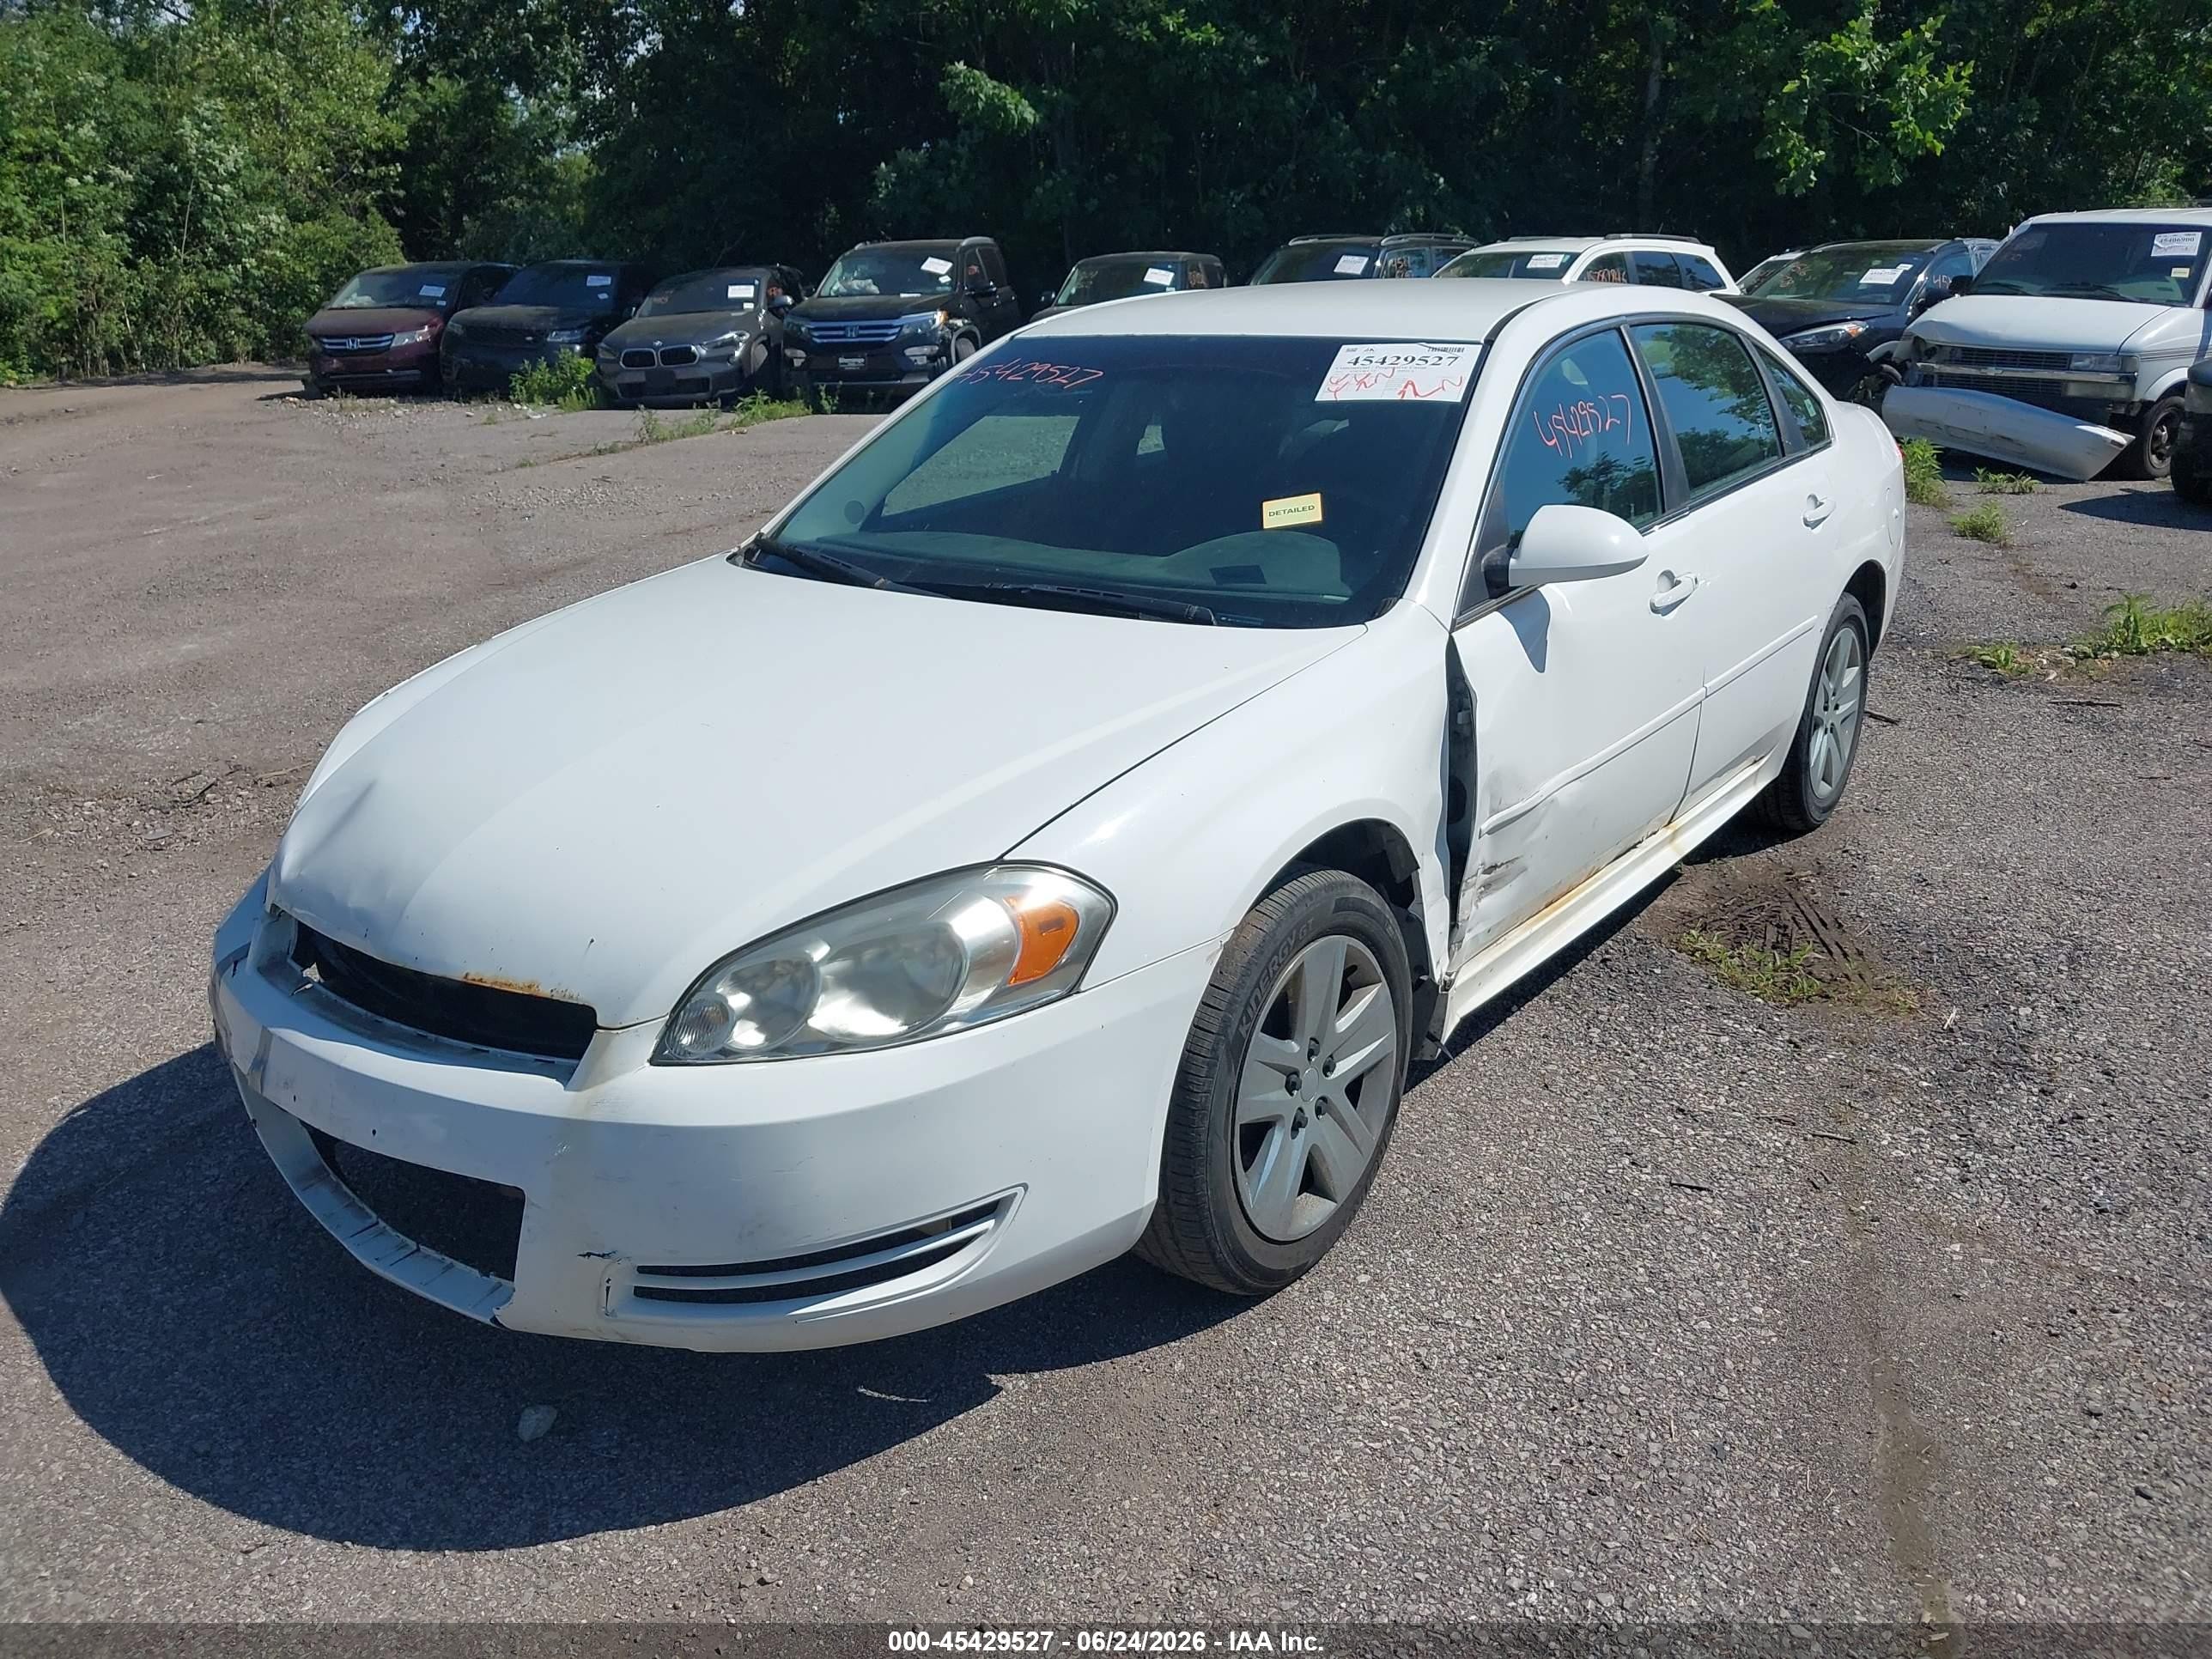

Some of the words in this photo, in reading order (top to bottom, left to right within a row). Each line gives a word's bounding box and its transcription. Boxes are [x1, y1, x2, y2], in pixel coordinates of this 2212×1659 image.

[957, 357, 1104, 390] 45429527
[1346, 356, 1462, 367] 45429527
[1534, 393, 1632, 459] 45429527
[1268, 504, 1316, 517] DETAILED
[1237, 929, 1296, 1038] KINERGY
